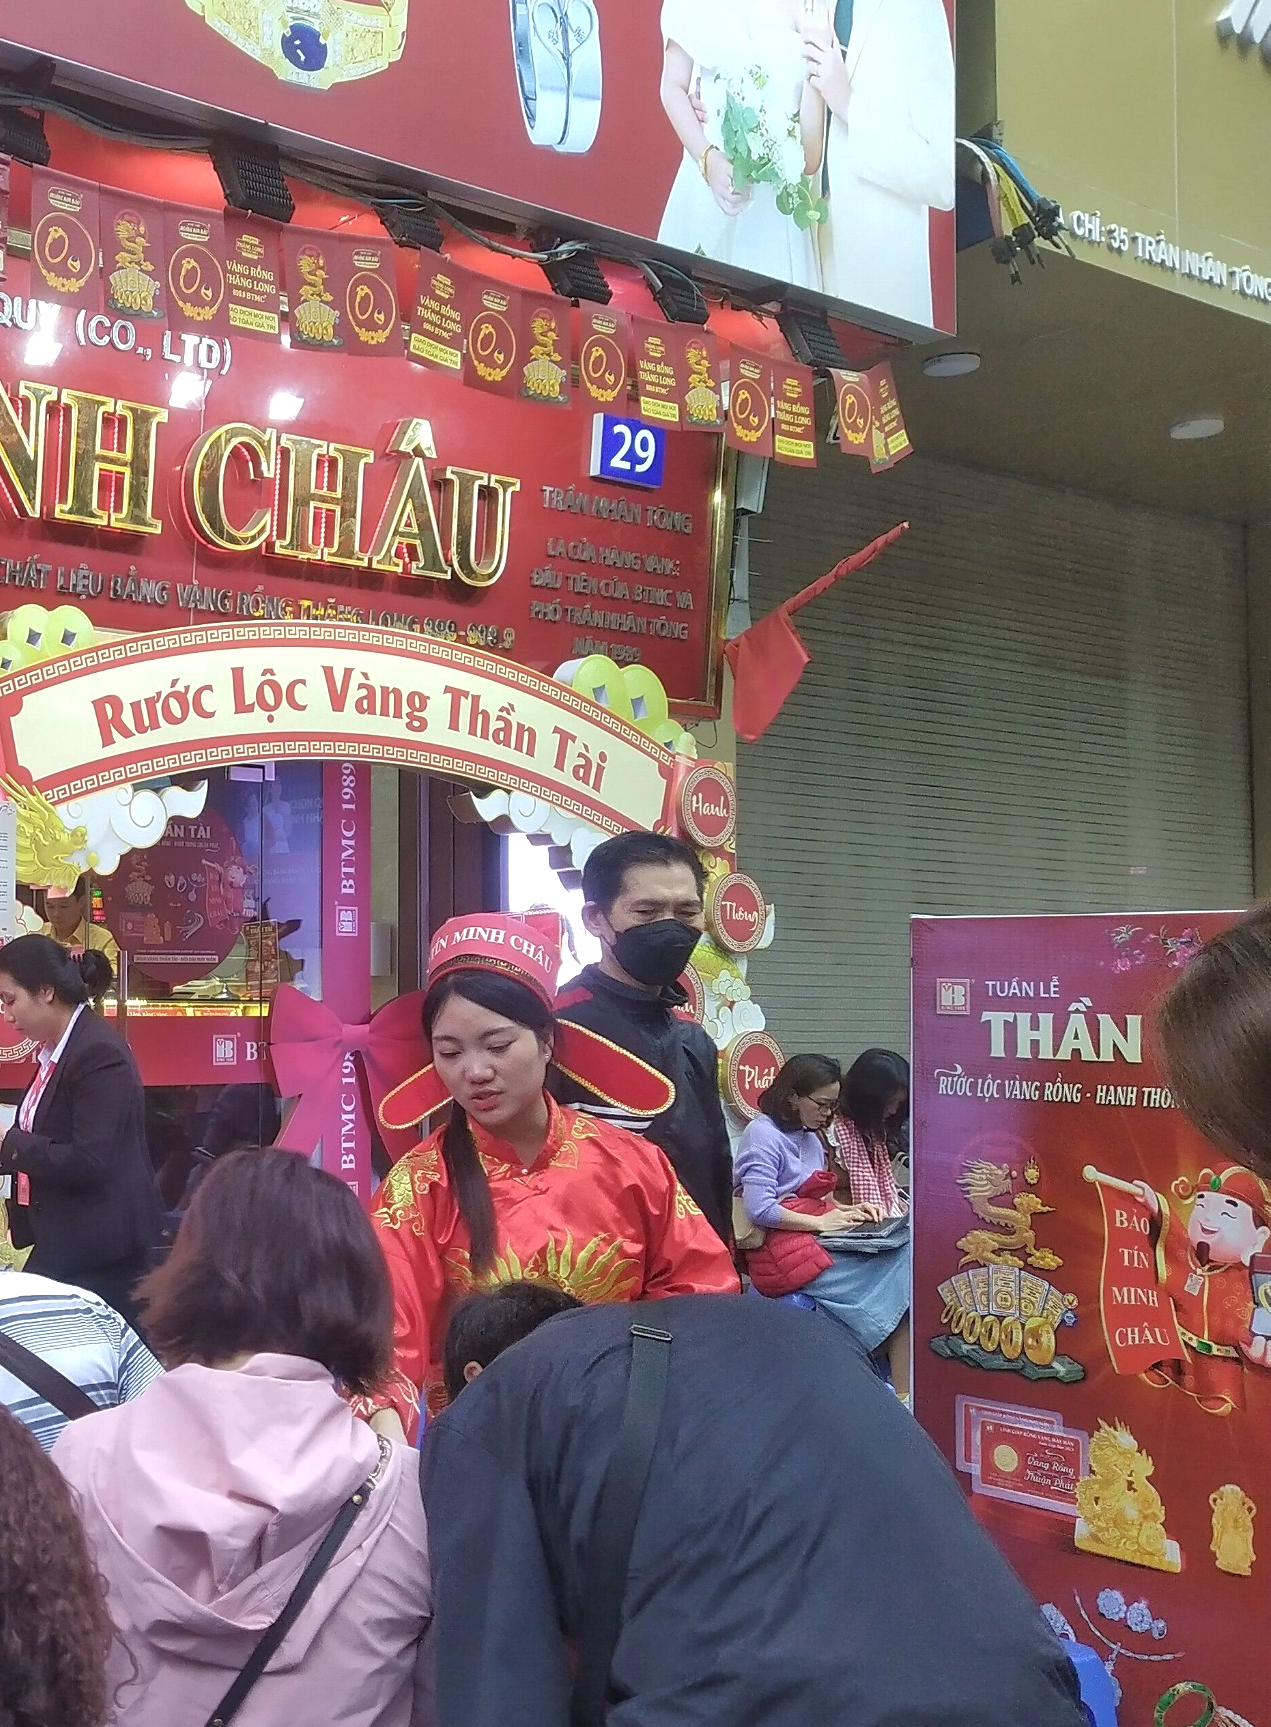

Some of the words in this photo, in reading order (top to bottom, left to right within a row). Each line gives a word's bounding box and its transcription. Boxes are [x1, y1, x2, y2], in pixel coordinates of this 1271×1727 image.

[1072, 210, 1107, 243] CHỈ:
[1108, 223, 1129, 252] 35
[1135, 229, 1181, 271] TRẦN
[1182, 251, 1227, 288] NHÂN
[226, 259, 249, 275] VÀNG
[250, 264, 274, 281] RỒNG
[253, 280, 276, 294] LONG
[417, 305, 441, 325] THĂNG
[441, 318, 462, 333] LONG
[420, 294, 440, 312] VÀNG
[440, 304, 461, 321] RỒNG
[161, 329, 232, 376] LTD)
[659, 376, 676, 387] LONG
[609, 423, 657, 474] 29
[184, 417, 521, 588] CHÂU
[541, 484, 590, 517] TRẦN
[592, 494, 642, 525] NHÂN
[646, 505, 693, 534] TÔNG
[56, 562, 104, 600] LIỆU
[109, 564, 171, 607] BẰNG
[177, 578, 233, 614] VÀNG
[236, 583, 294, 621] RỒNG
[631, 584, 673, 609] BTMC
[530, 598, 563, 621] PHỐ
[565, 603, 605, 627] TRẦN
[604, 609, 647, 636] NHÂN
[648, 615, 690, 641] TÔNG
[90, 677, 216, 750] Rước
[230, 666, 308, 724] Lộc
[320, 665, 431, 731] Vàng
[443, 684, 538, 759] Thần
[551, 725, 610, 794] Tài
[341, 762, 356, 811] 1989
[691, 792, 729, 818] Hanh
[188, 824, 211, 839] TÀI
[340, 818, 357, 895] BTMC
[721, 900, 759, 930] Thông
[451, 926, 507, 946] MINH
[509, 935, 553, 974] CHÂU
[984, 976, 1035, 998] TUẦN
[1039, 975, 1060, 998] LỄ
[980, 997, 1143, 1064] THẦN
[739, 1064, 776, 1090] Phát
[936, 1066, 973, 1097] RƯỚC
[976, 1074, 1002, 1103] LỘC
[1005, 1075, 1040, 1101] VÀNG
[1043, 1072, 1082, 1103] RỒNG
[1095, 1084, 1137, 1106] HANH
[341, 1093, 356, 1170] BTMC
[1114, 1207, 1151, 1235] BẢO
[1119, 1248, 1149, 1270] TÍN
[1111, 1286, 1159, 1309] MINH
[1115, 1322, 1170, 1348] CHÂU
